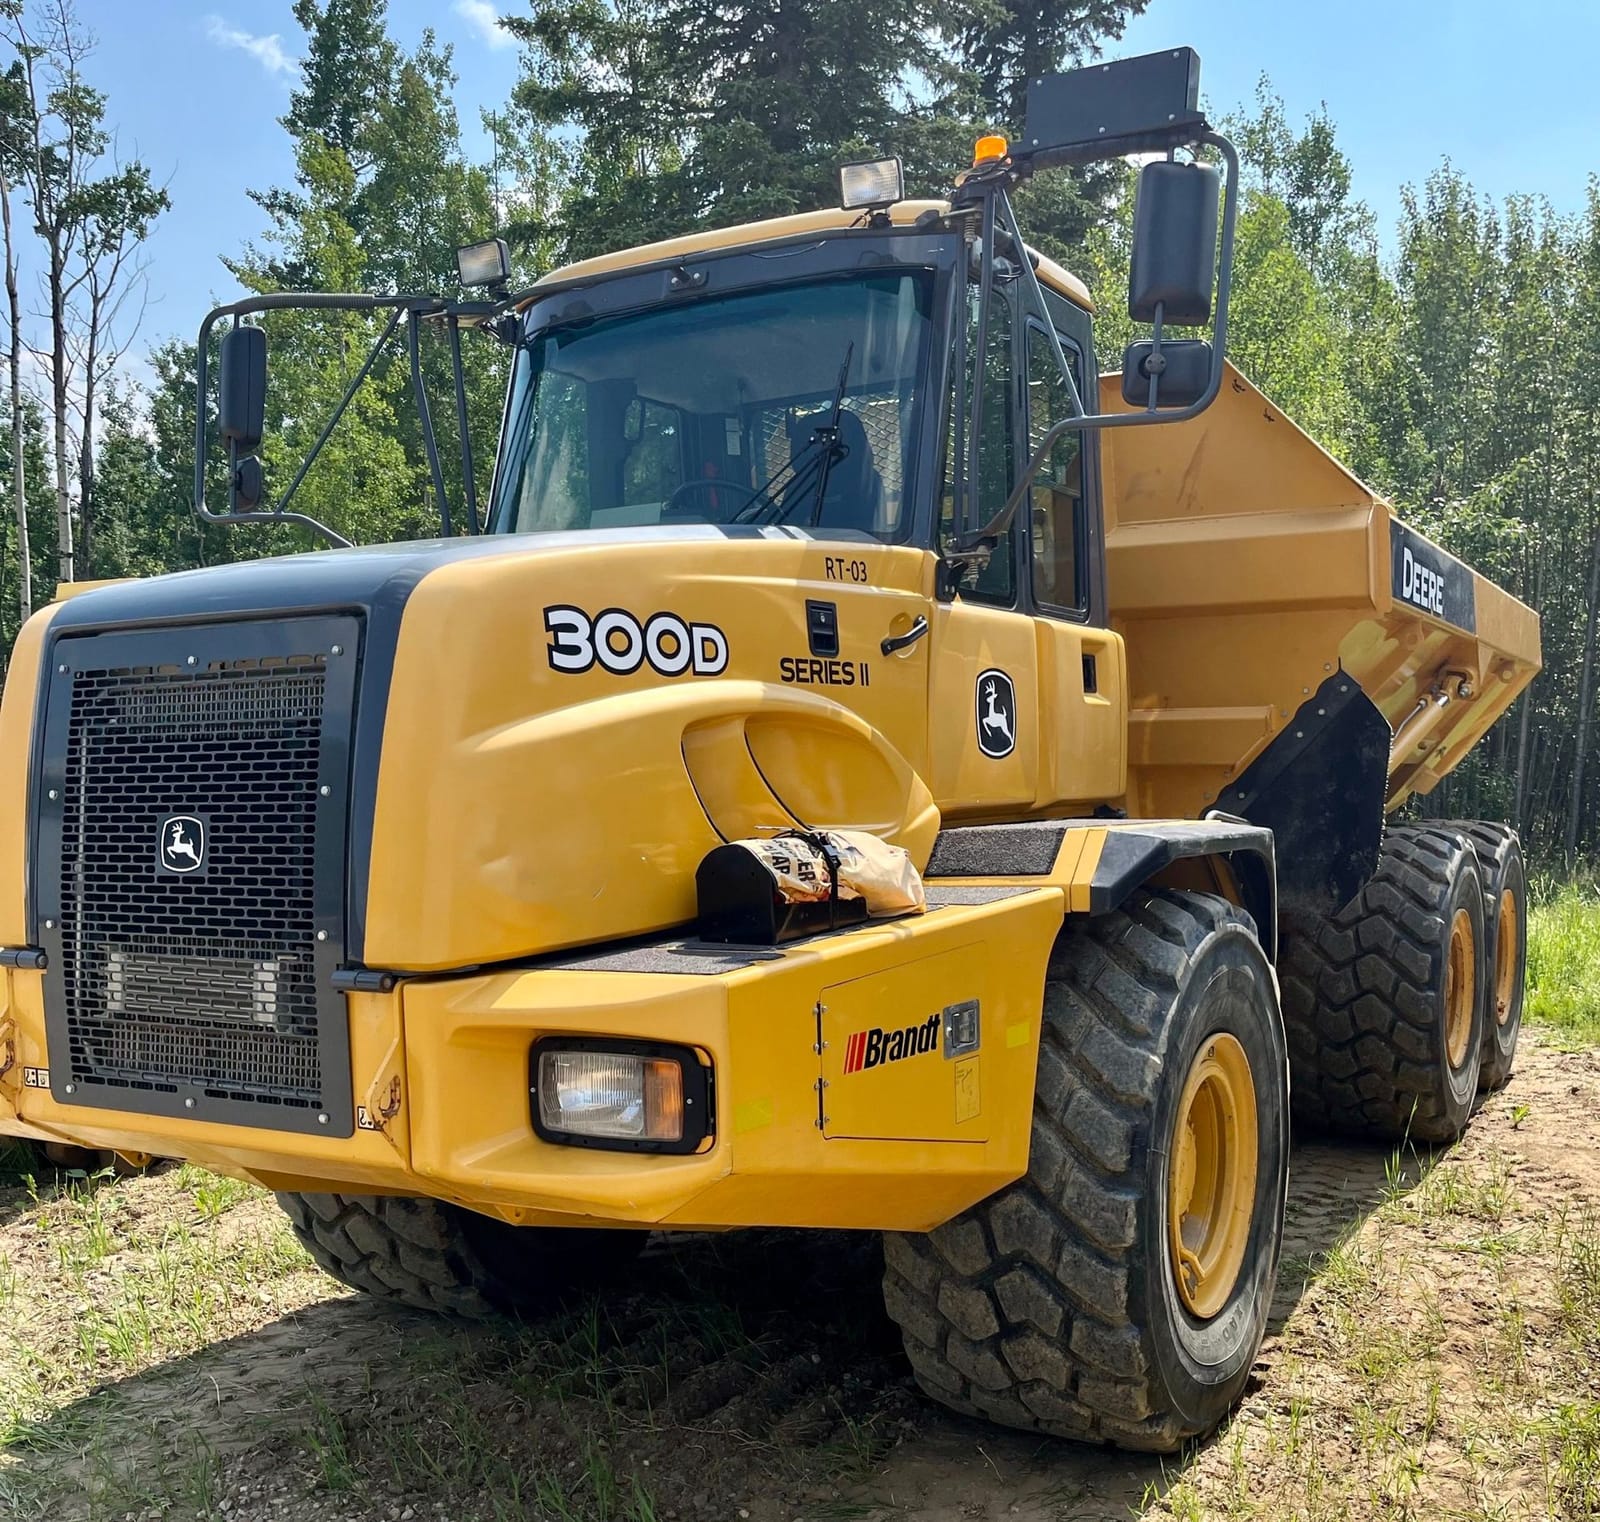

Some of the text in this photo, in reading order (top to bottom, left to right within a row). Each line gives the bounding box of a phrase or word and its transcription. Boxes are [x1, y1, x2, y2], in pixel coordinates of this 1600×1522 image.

[825, 556, 868, 582] RT-03
[1402, 546, 1445, 615] DEERE
[543, 604, 729, 677] 300D
[779, 657, 870, 687] SERIES II
[863, 1013, 941, 1070] Brandt
